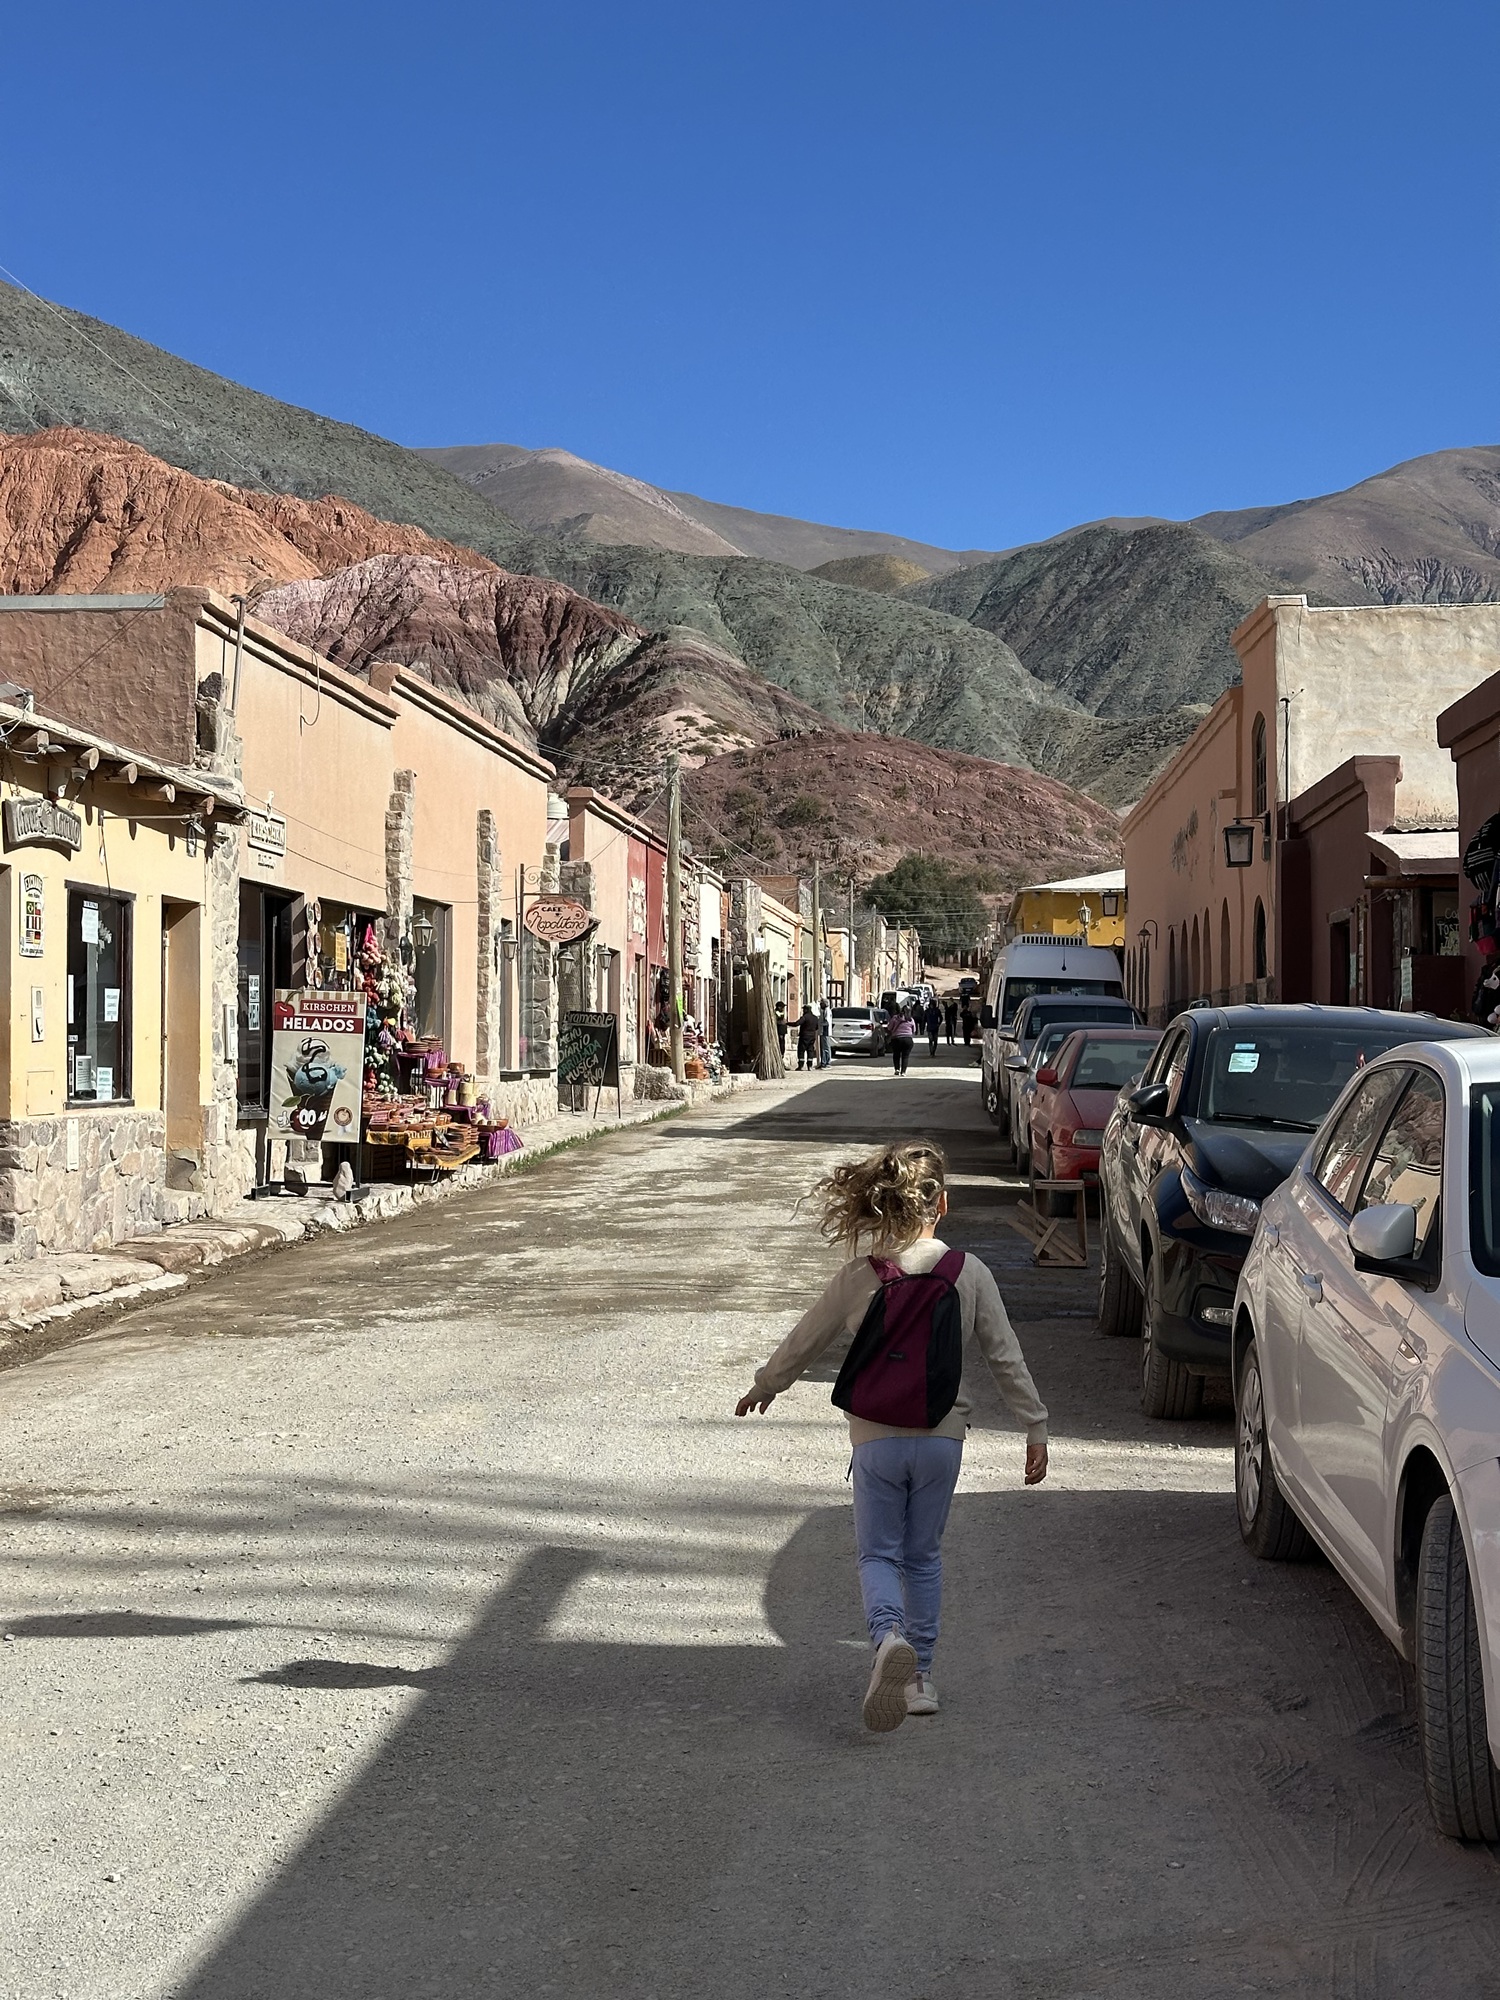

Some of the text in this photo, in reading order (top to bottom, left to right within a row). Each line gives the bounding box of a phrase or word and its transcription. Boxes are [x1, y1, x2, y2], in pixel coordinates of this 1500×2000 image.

[303, 1003, 355, 1013] KIRSCHEN
[283, 1017, 355, 1032] HELADOS
[558, 1040, 602, 1078] ARRILLADA
